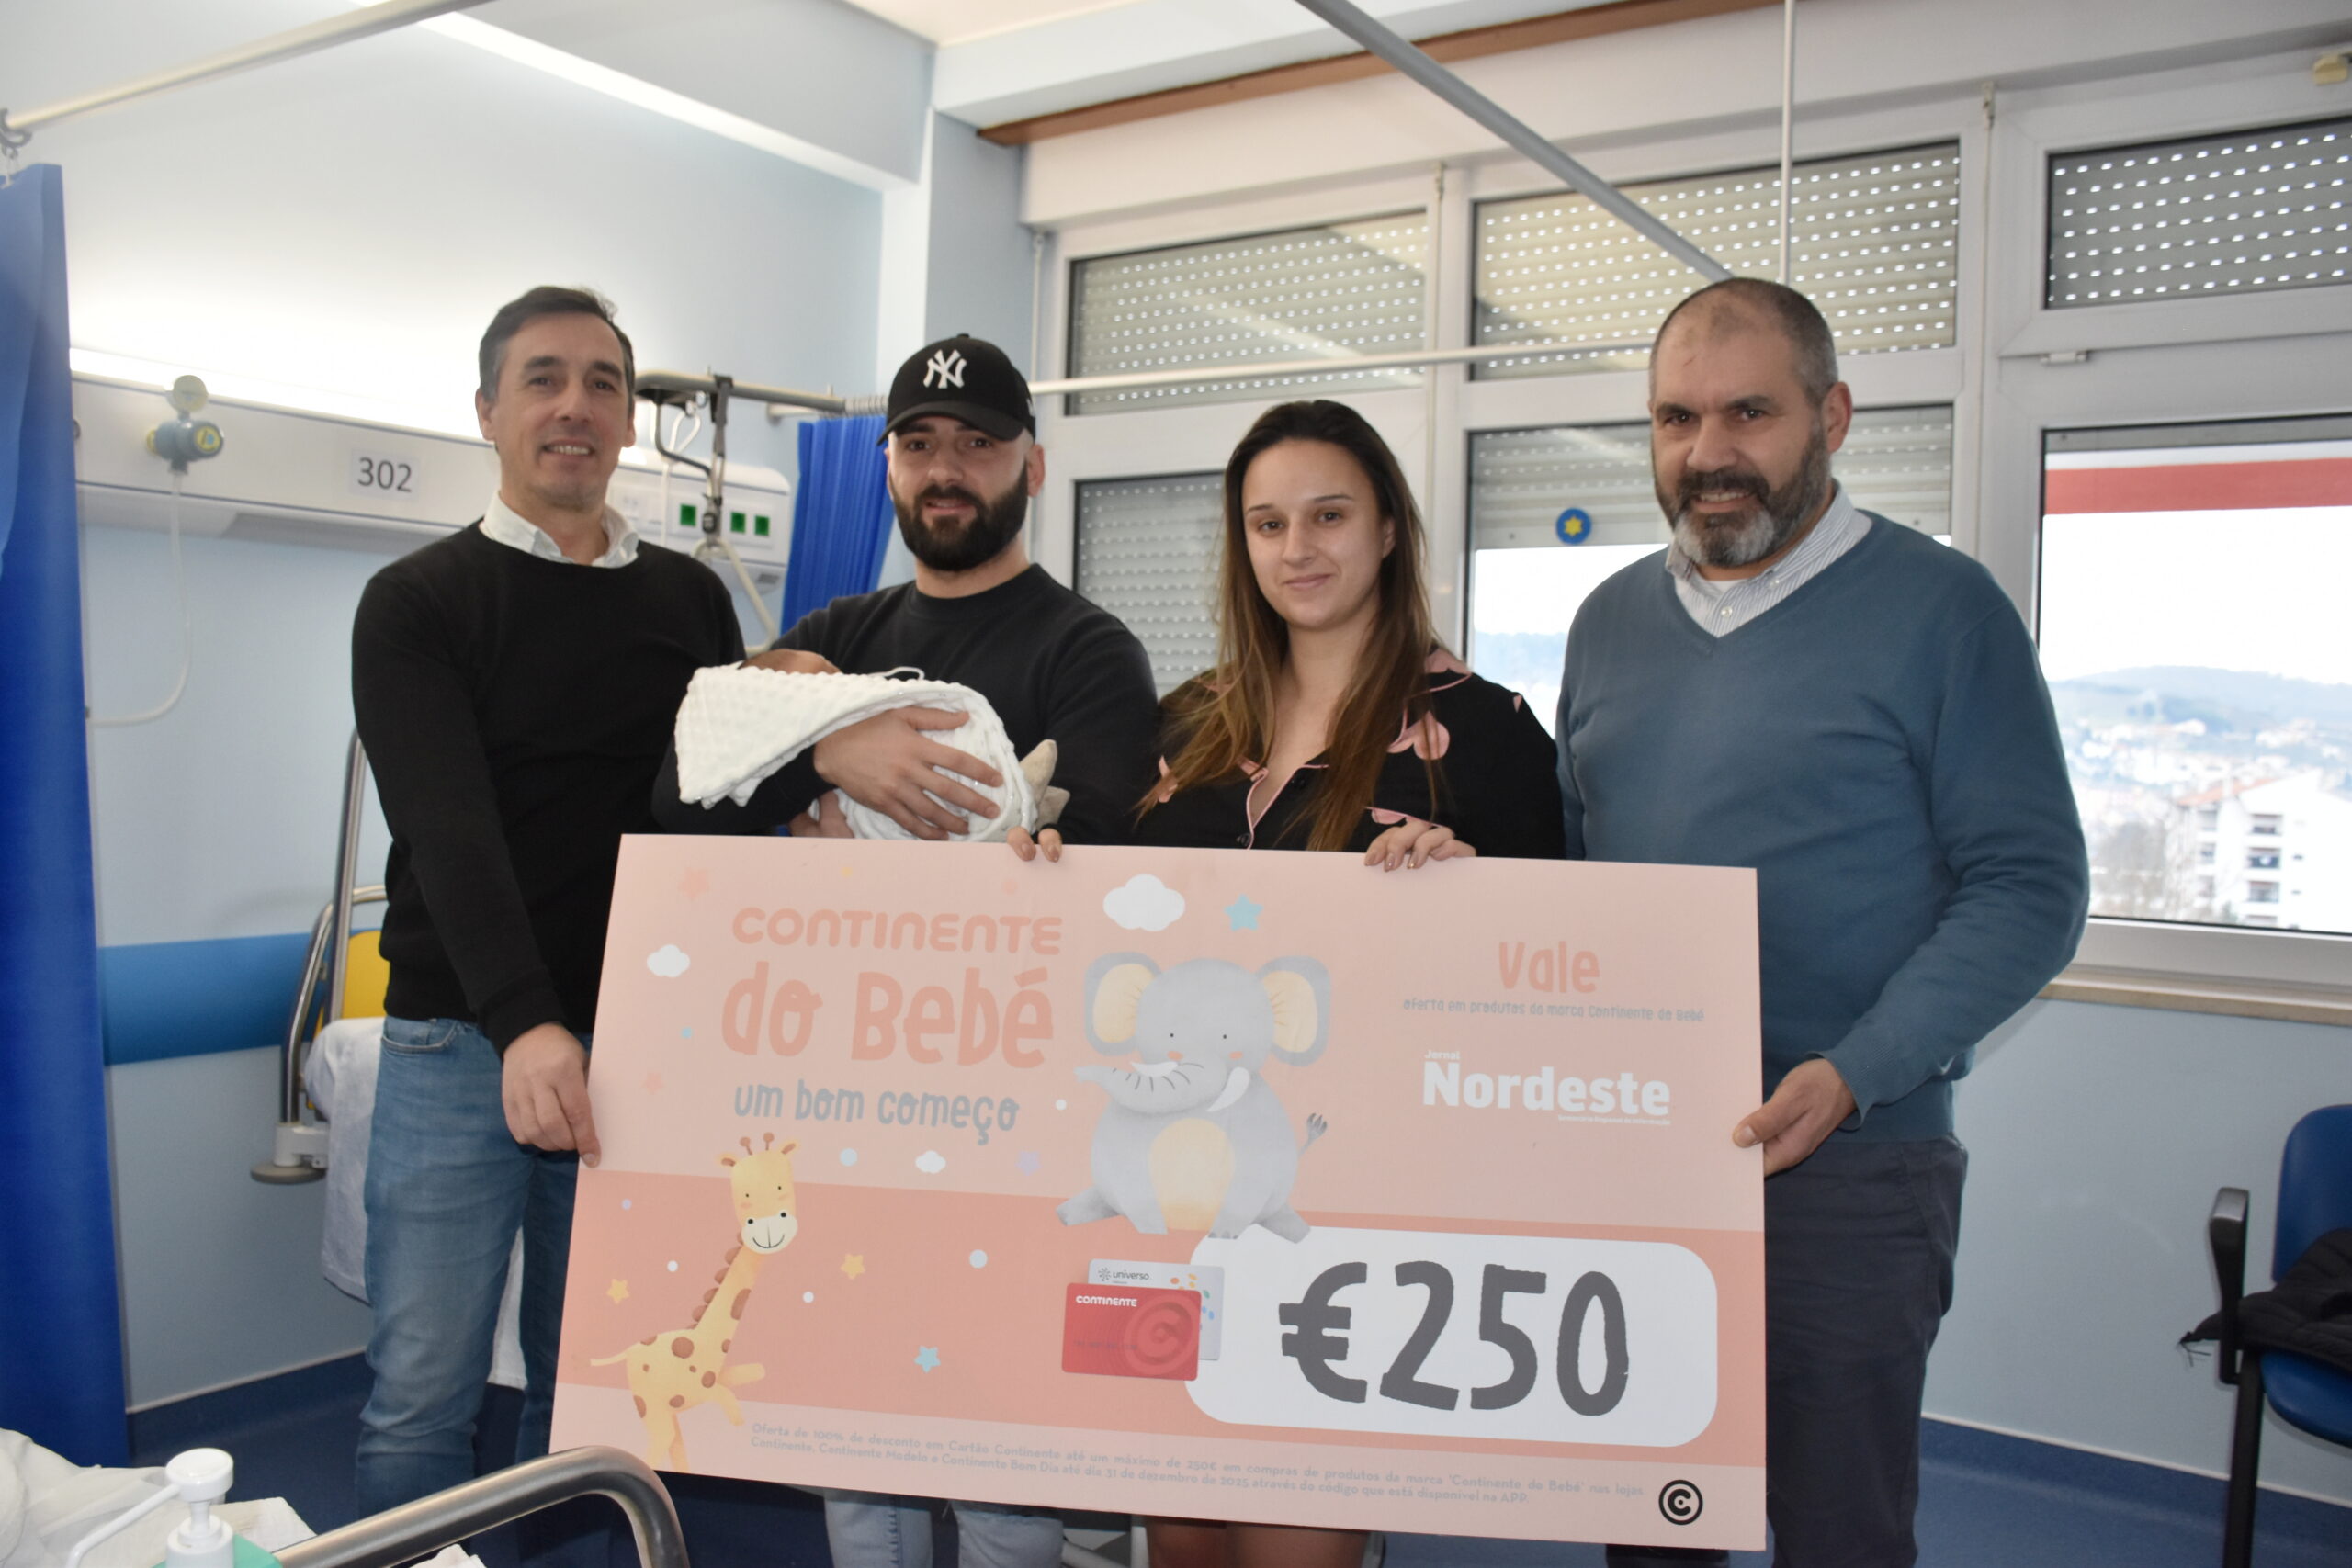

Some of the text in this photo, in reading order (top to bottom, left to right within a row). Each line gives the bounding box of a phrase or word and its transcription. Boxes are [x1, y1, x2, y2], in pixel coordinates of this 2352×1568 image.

[358, 457, 412, 492] 302
[732, 908, 1062, 955] CONTINENTE
[1499, 941, 1600, 994] Vale
[721, 961, 1053, 1068] do Bebé
[1403, 998, 1444, 1012] oferta
[1448, 1000, 1466, 1012] em
[1470, 1000, 1525, 1015] produtos
[1547, 1004, 1583, 1017] marca
[1589, 1005, 1654, 1021] Continente
[735, 1079, 1020, 1145] um bom começo
[1423, 1061, 1670, 1116] Nordeste
[1076, 1295, 1137, 1306] CONTINENTE
[1113, 1269, 1149, 1280] universo
[1279, 1260, 1629, 1416] €250
[752, 1423, 789, 1437] Oferta
[794, 1427, 808, 1438] de
[850, 1432, 863, 1443] de
[869, 1433, 921, 1449] desconto
[926, 1440, 943, 1450] em
[948, 1440, 989, 1454] Cartão
[994, 1444, 1060, 1460] Continente
[1066, 1449, 1085, 1461] até
[1090, 1453, 1108, 1462] um
[1114, 1453, 1160, 1467] máximo
[1166, 1457, 1181, 1468] de
[1223, 1463, 1240, 1472] em
[1247, 1464, 1298, 1478] compras
[1304, 1465, 1319, 1477] de
[1324, 1469, 1380, 1482] produtos
[1385, 1471, 1400, 1483] da
[1406, 1475, 1443, 1484] marca
[819, 1442, 882, 1459] Continente
[886, 1450, 928, 1463] Modelo
[942, 1453, 1007, 1470] Continente
[1062, 1463, 1081, 1475] até
[1084, 1464, 1102, 1477] dia
[1120, 1468, 1135, 1479] de
[1138, 1470, 1199, 1484] dezembro
[1202, 1473, 1216, 1484] de
[1252, 1478, 1295, 1490] através
[1318, 1482, 1359, 1496] código
[1362, 1485, 1385, 1496] que
